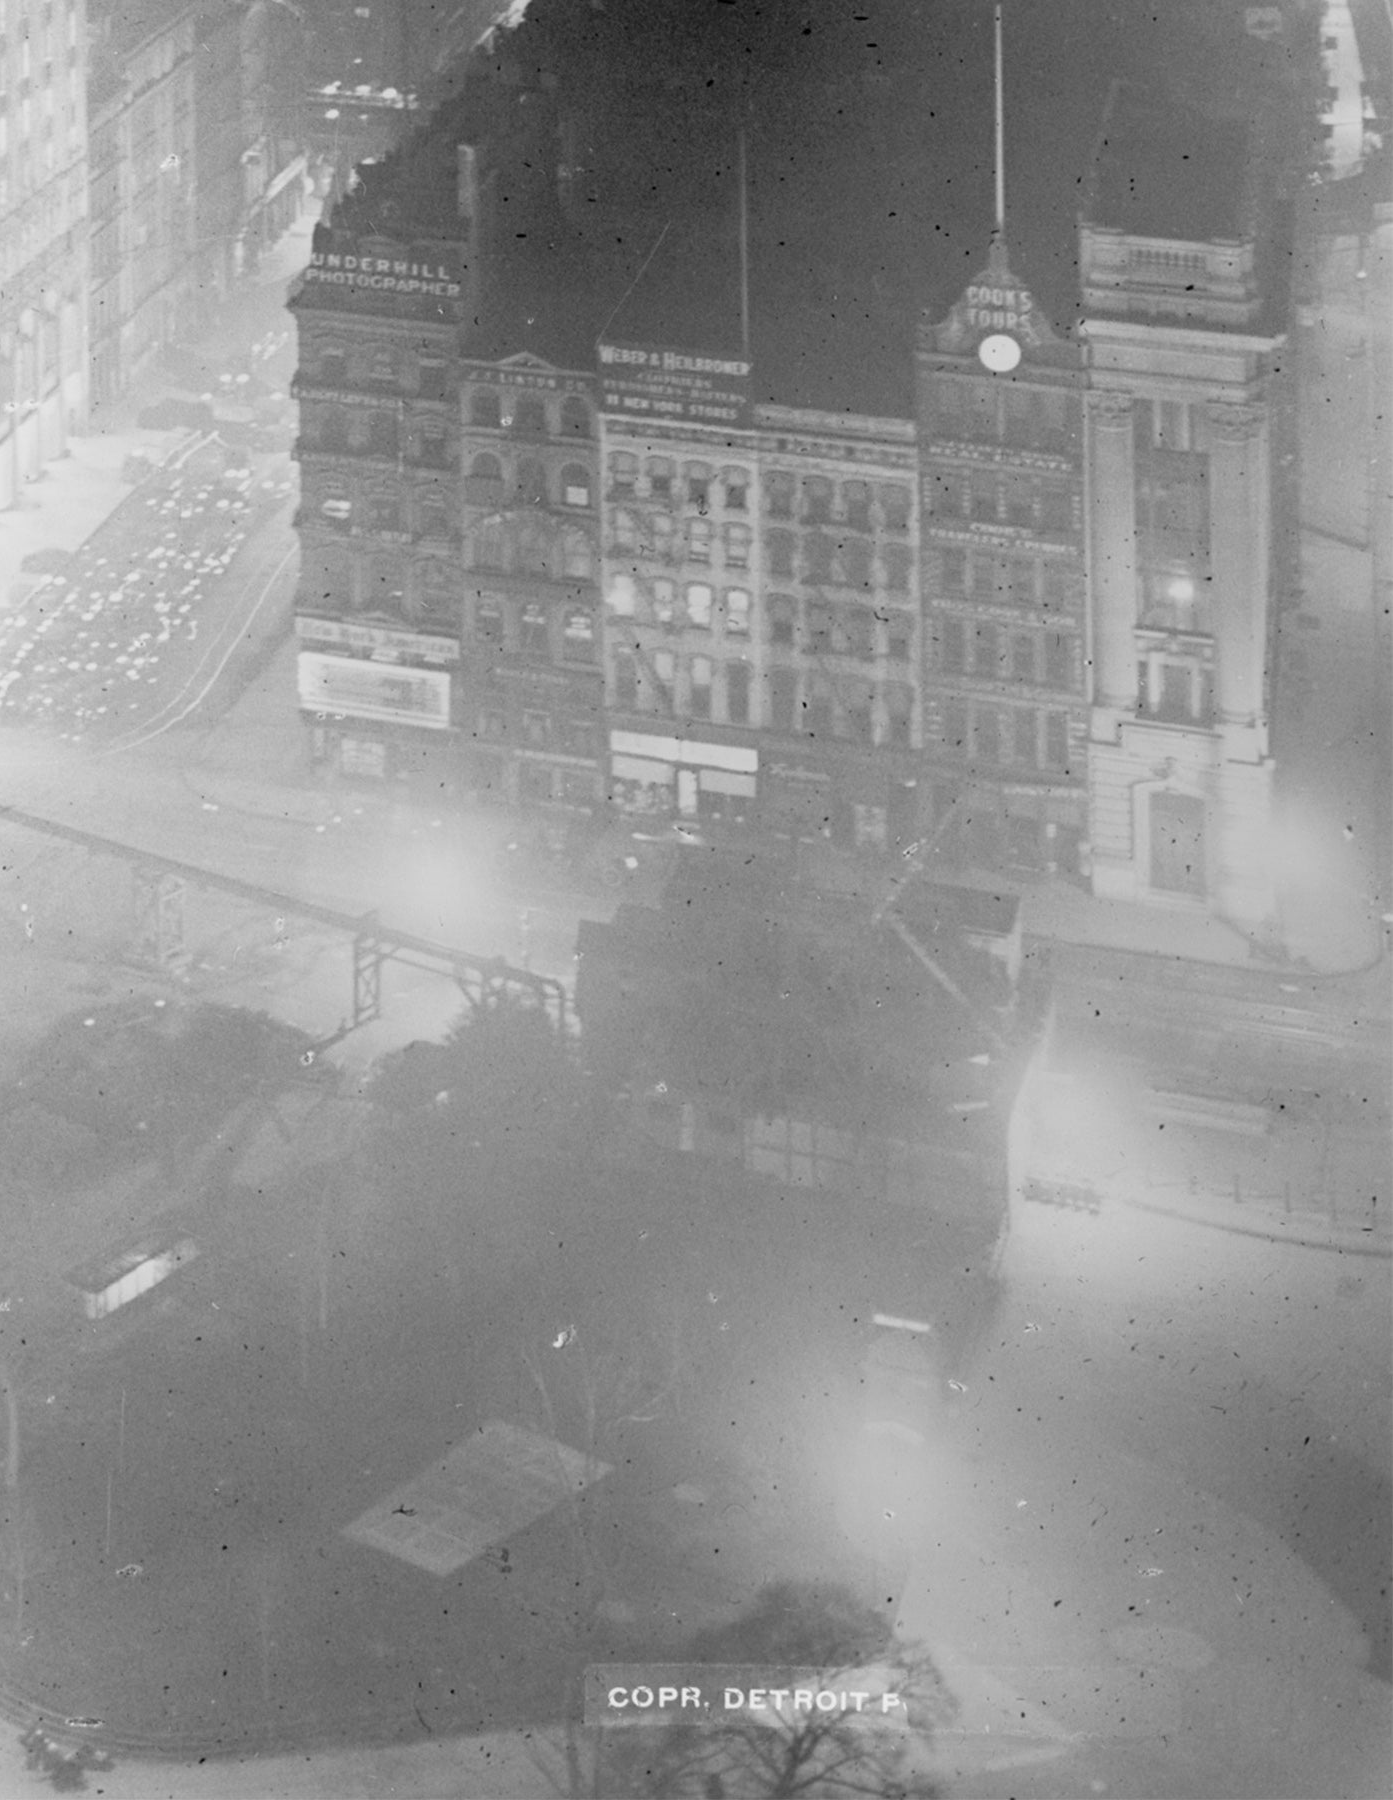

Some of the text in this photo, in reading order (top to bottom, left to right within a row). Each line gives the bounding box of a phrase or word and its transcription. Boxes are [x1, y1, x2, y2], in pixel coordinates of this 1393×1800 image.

[311, 254, 449, 279] UNDERHILL
[306, 270, 460, 295] PHOTOGRAPHER
[966, 309, 1032, 329] TOURS
[599, 345, 646, 364] WEBER
[649, 352, 661, 366] &
[624, 397, 649, 408] NEW
[653, 401, 683, 412] YORK
[690, 404, 737, 419] STORES
